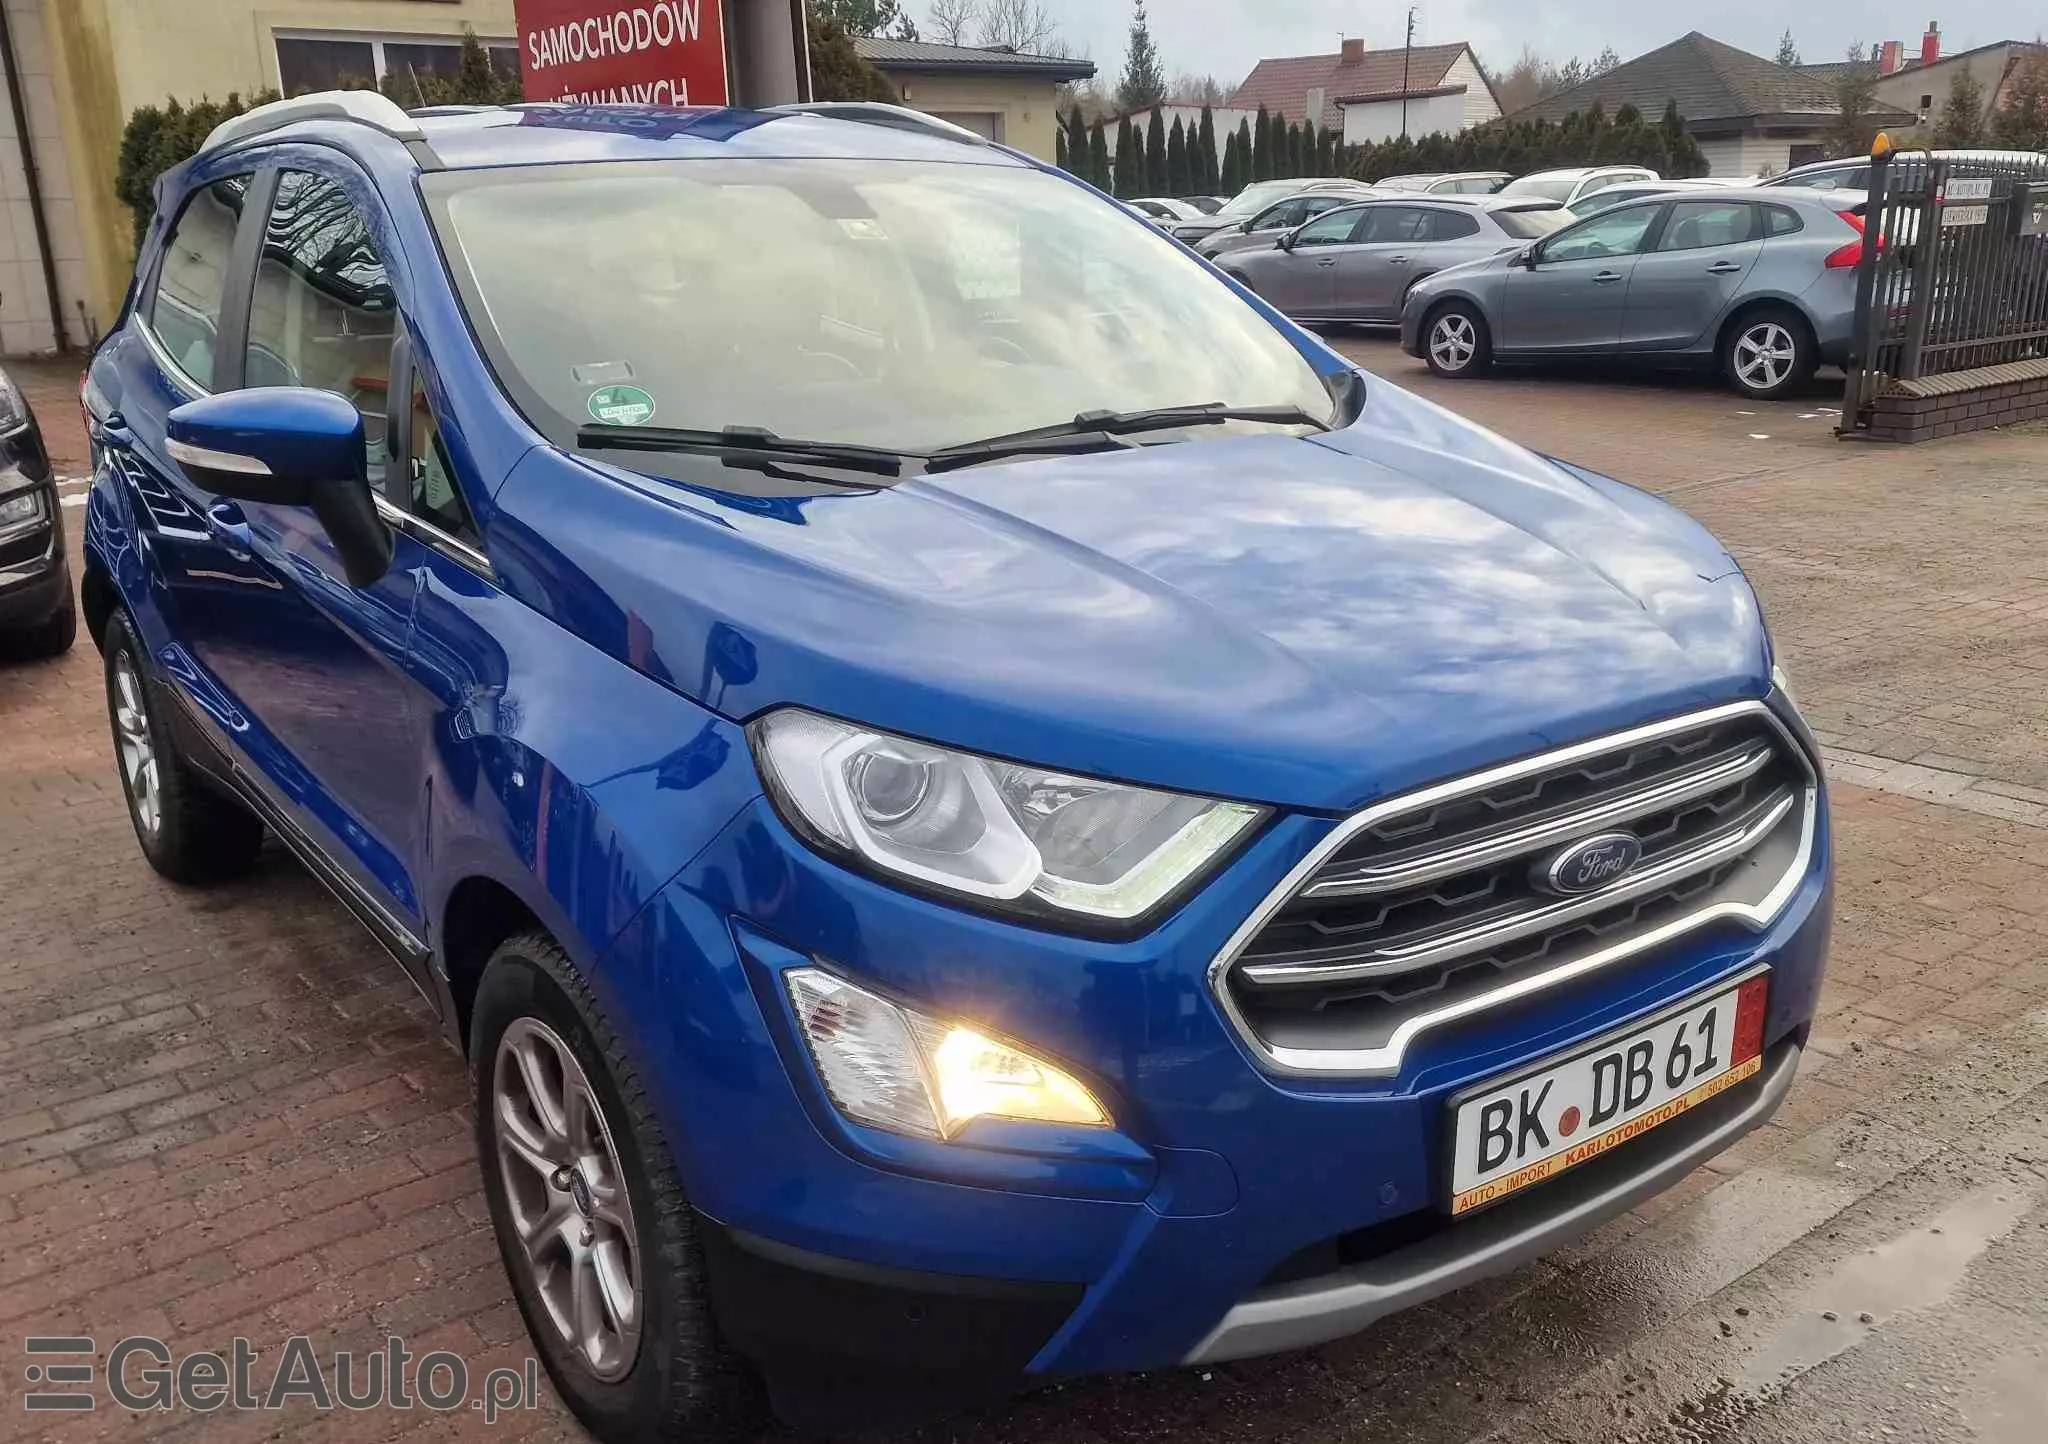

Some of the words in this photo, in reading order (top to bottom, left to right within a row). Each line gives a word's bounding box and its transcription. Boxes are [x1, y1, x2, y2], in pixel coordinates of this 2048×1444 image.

[529, 0, 700, 71] SAMOCHODÓW
[1578, 845, 1626, 883] Ford
[1477, 1079, 1555, 1174] BK
[1588, 1039, 1655, 1129] DB
[1665, 1006, 1718, 1089] 61
[1460, 1185, 1495, 1210] AUTO
[1506, 1161, 1553, 1190] IMPORT
[1565, 1097, 1690, 1166] KARI.OTOMOTO.PL
